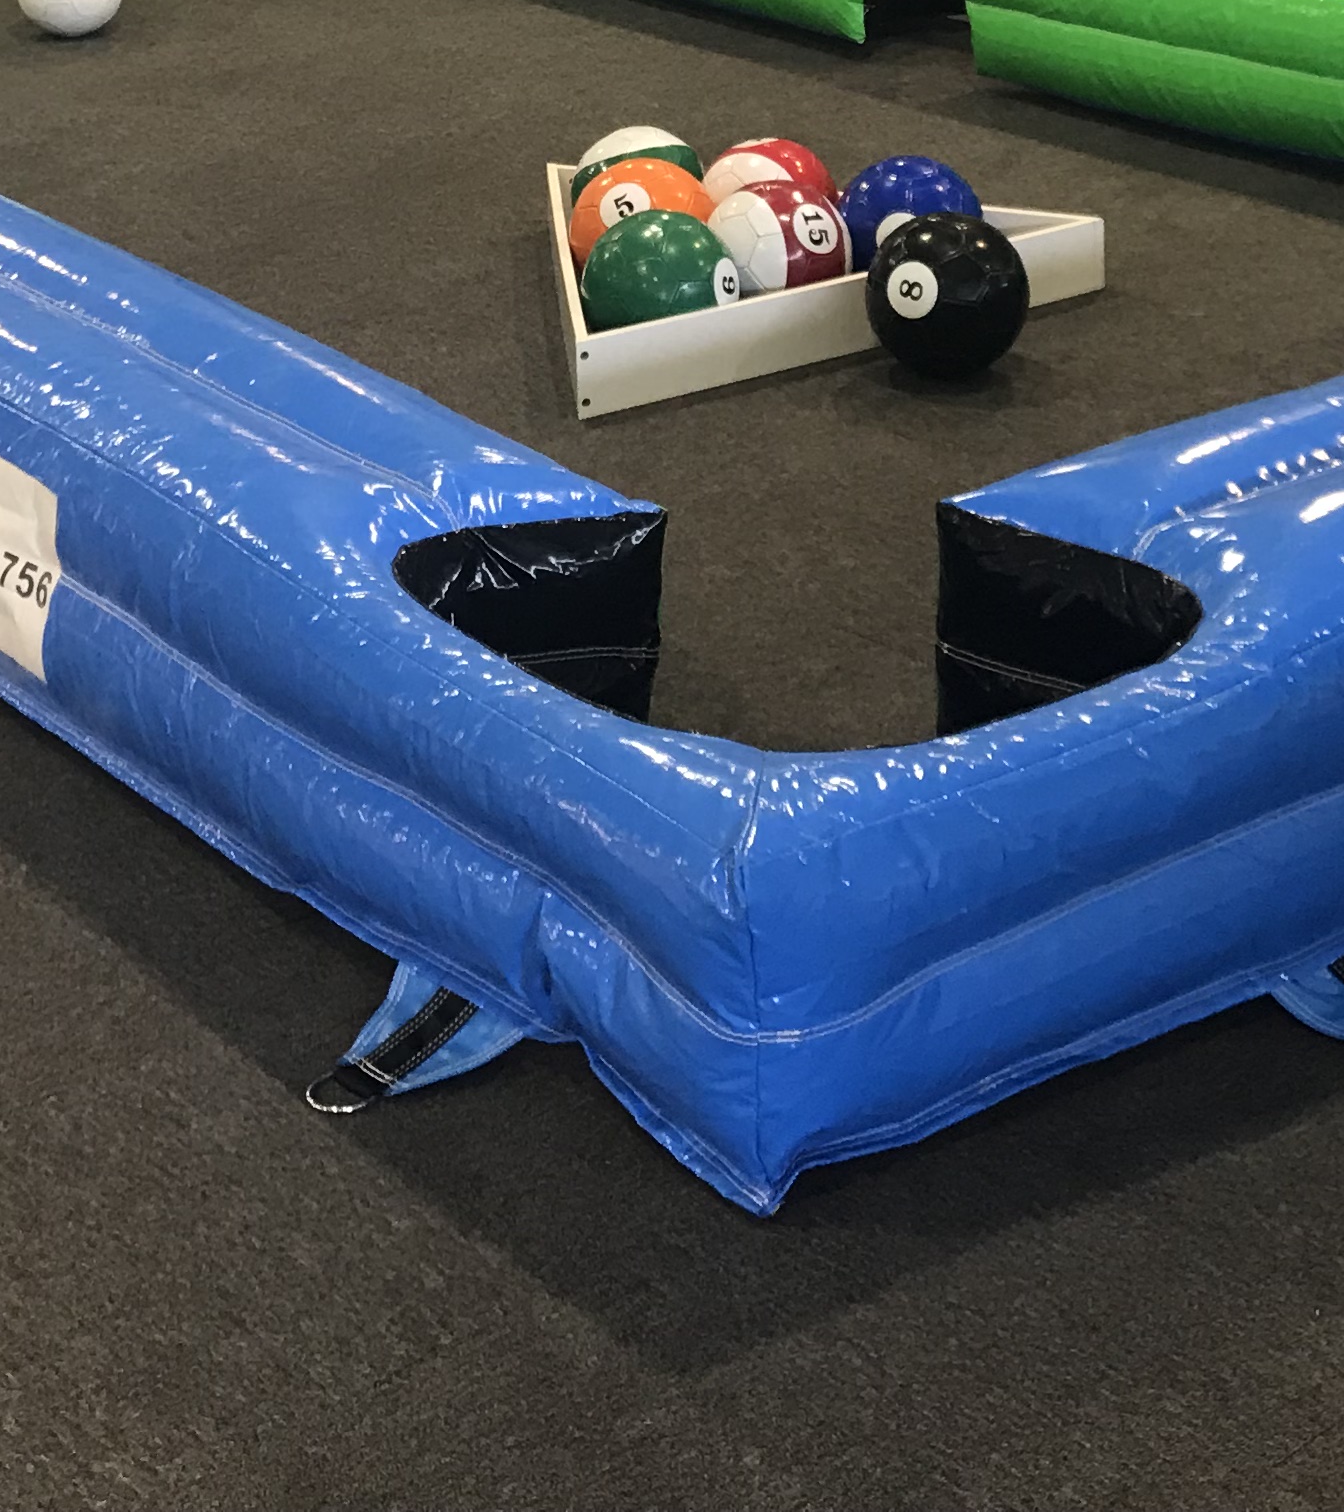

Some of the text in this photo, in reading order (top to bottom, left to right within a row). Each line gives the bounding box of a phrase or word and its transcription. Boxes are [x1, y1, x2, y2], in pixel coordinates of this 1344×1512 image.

[613, 192, 635, 219] 5
[801, 210, 831, 247] 15
[899, 279, 923, 302] 8
